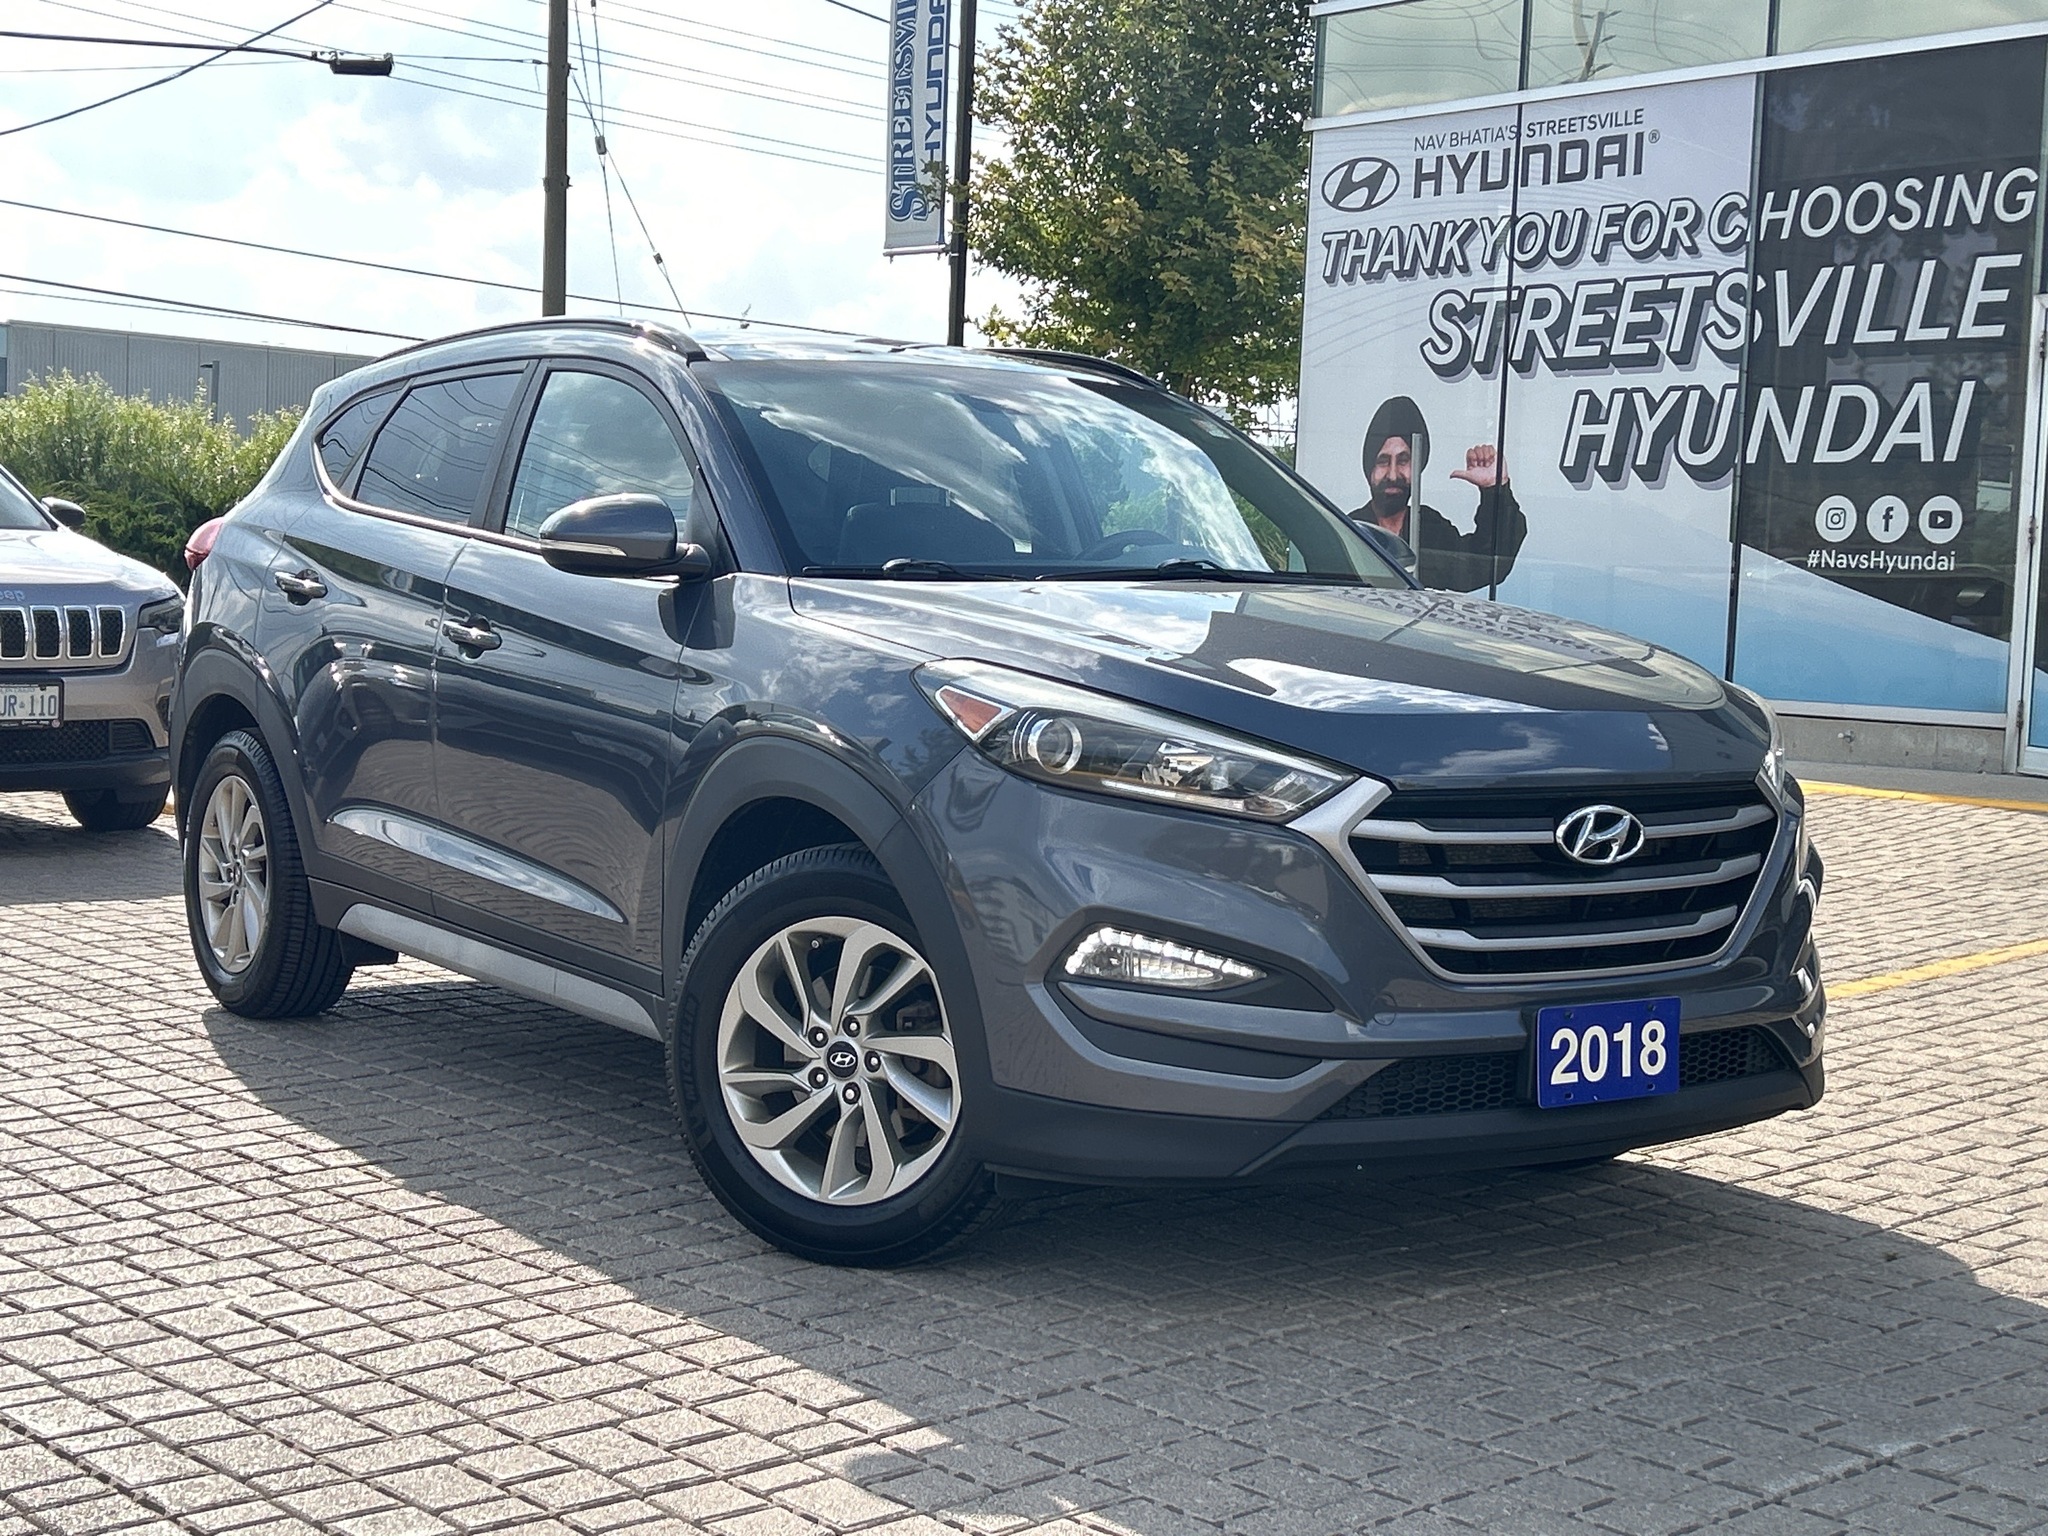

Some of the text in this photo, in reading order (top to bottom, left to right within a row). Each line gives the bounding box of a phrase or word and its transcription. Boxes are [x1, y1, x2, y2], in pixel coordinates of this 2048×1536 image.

[1413, 108, 1645, 152] NAV BHATIA'S STREETSVILLE
[1320, 166, 2039, 285] THANK YOU FOR CHOOSING
[1419, 253, 2024, 380] STREETSVILLE
[1560, 380, 1980, 487] HYUNDAI
[1806, 549, 1956, 573] #NavsHyundai
[1550, 1020, 1667, 1085] 2018
